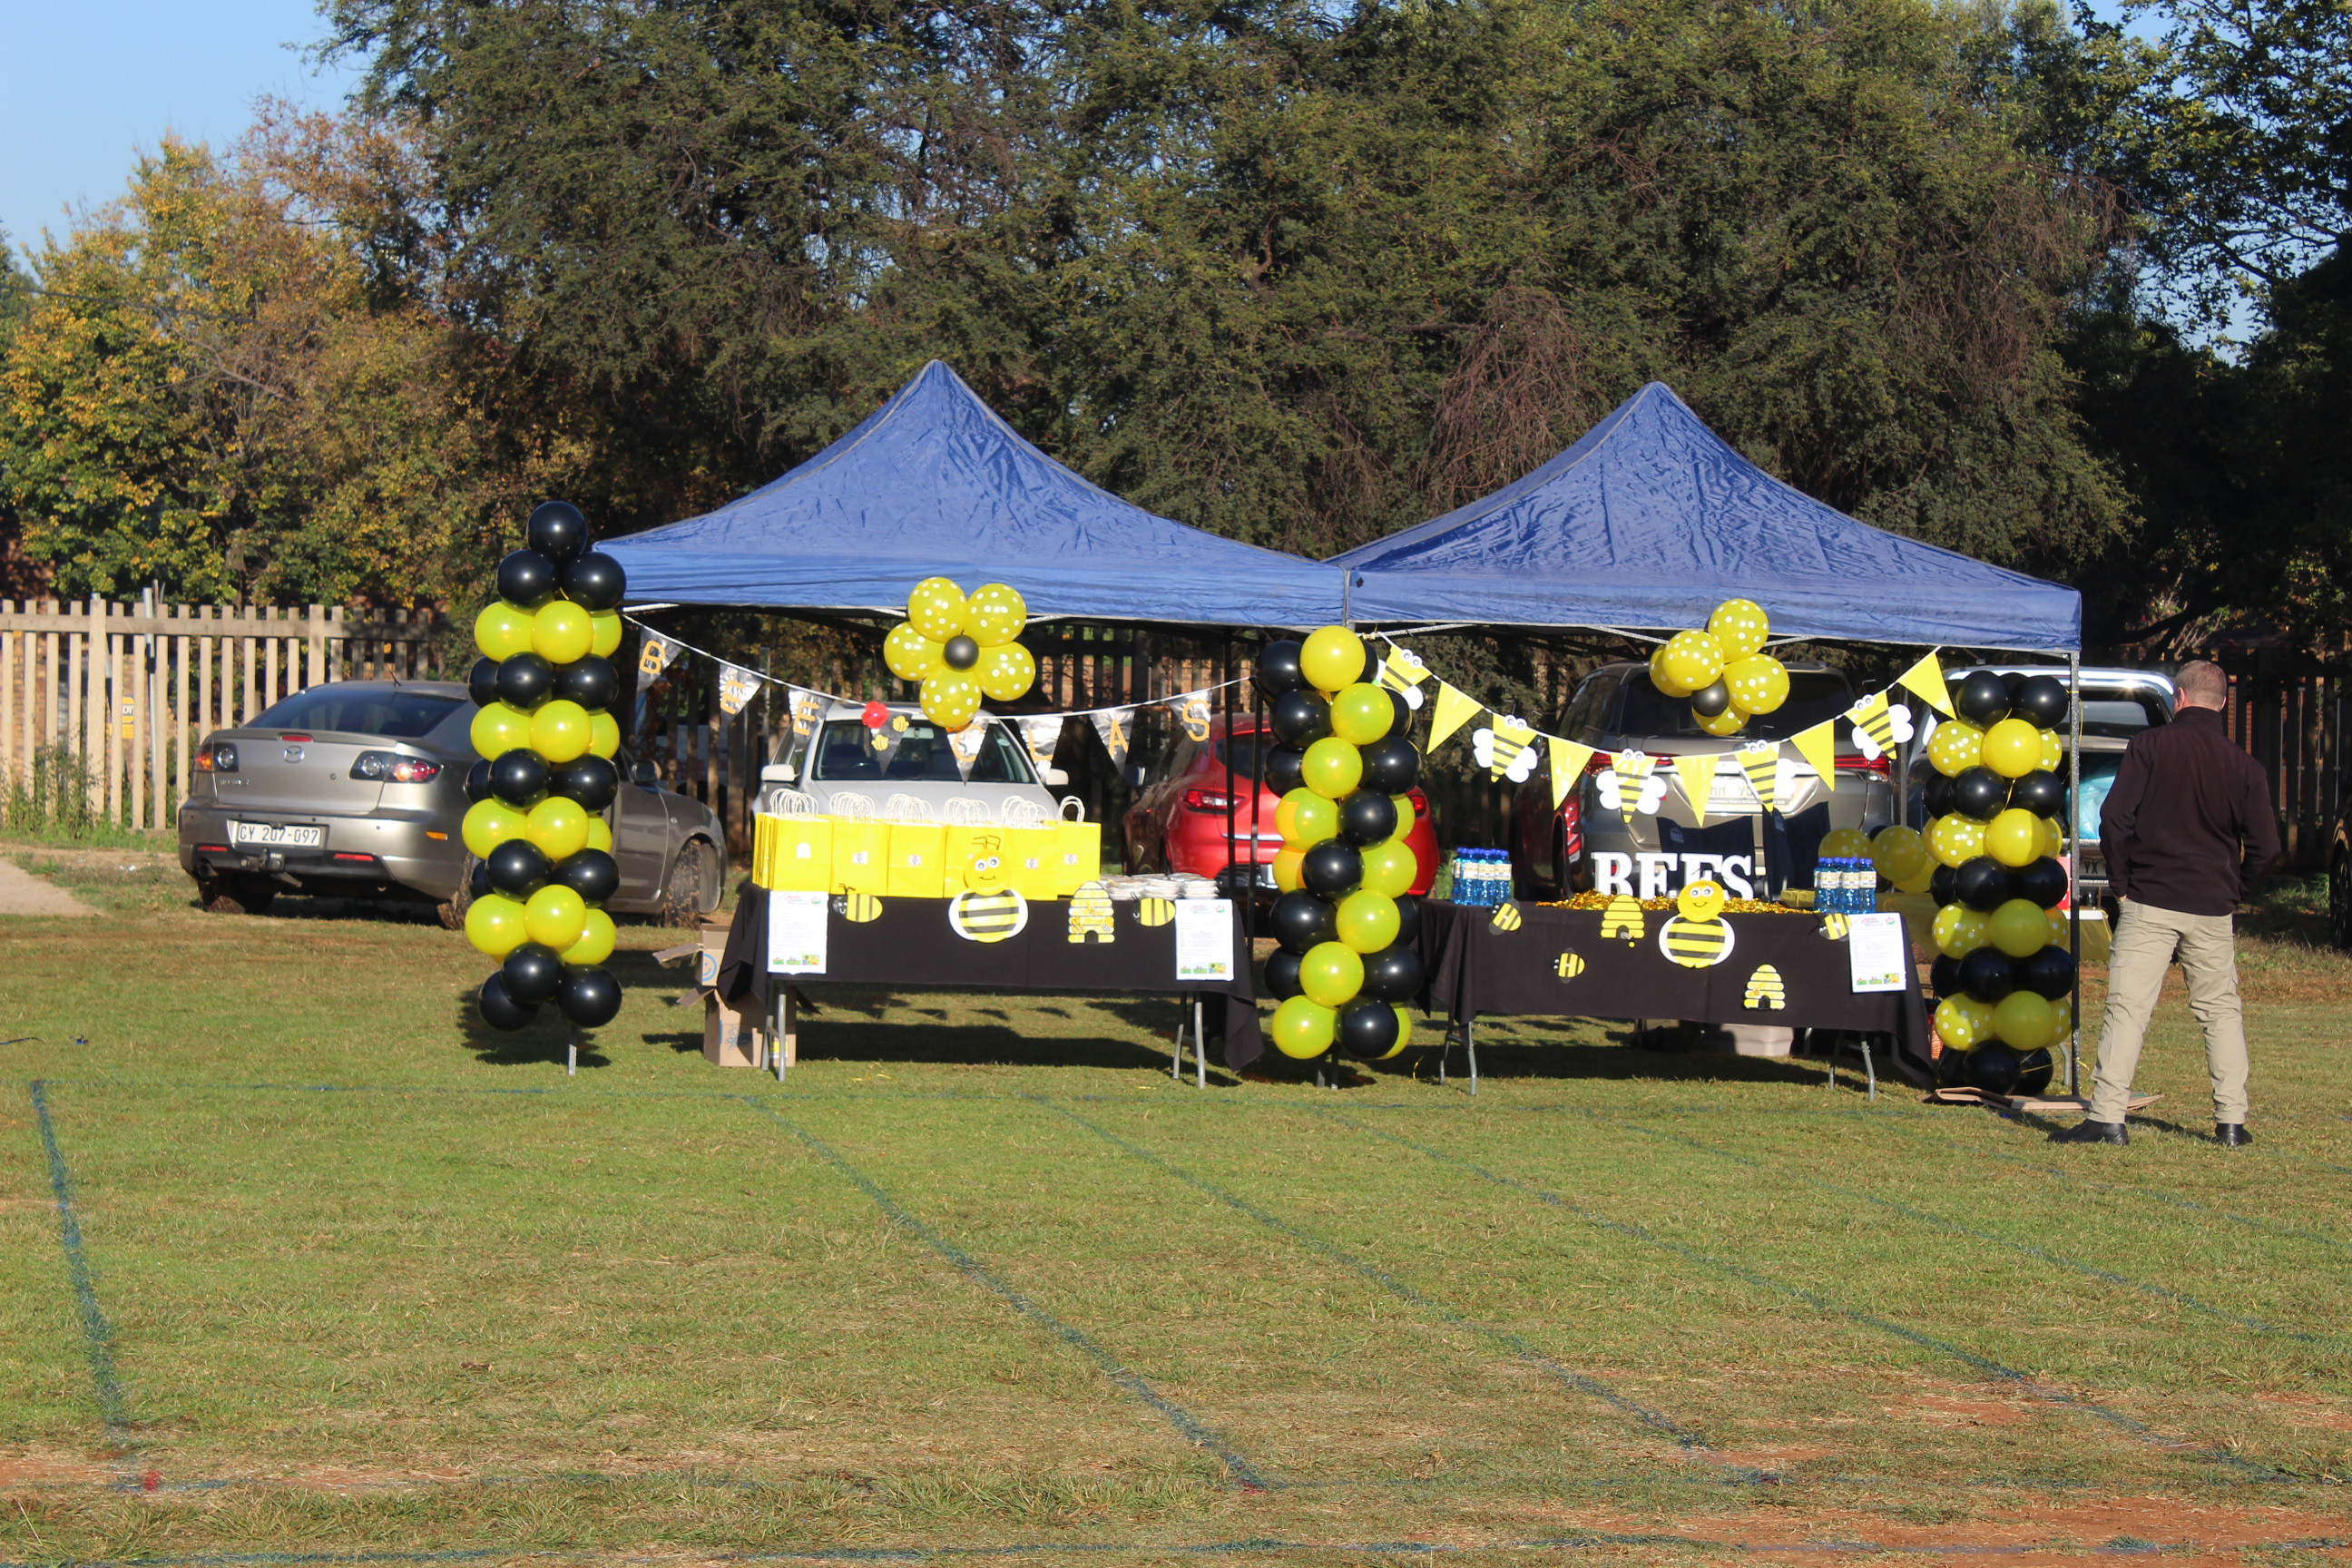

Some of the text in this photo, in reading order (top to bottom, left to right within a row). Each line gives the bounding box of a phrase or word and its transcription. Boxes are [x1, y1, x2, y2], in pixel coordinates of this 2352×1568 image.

[240, 825, 318, 844] CY 207-097
[1591, 851, 1753, 900] BEES
